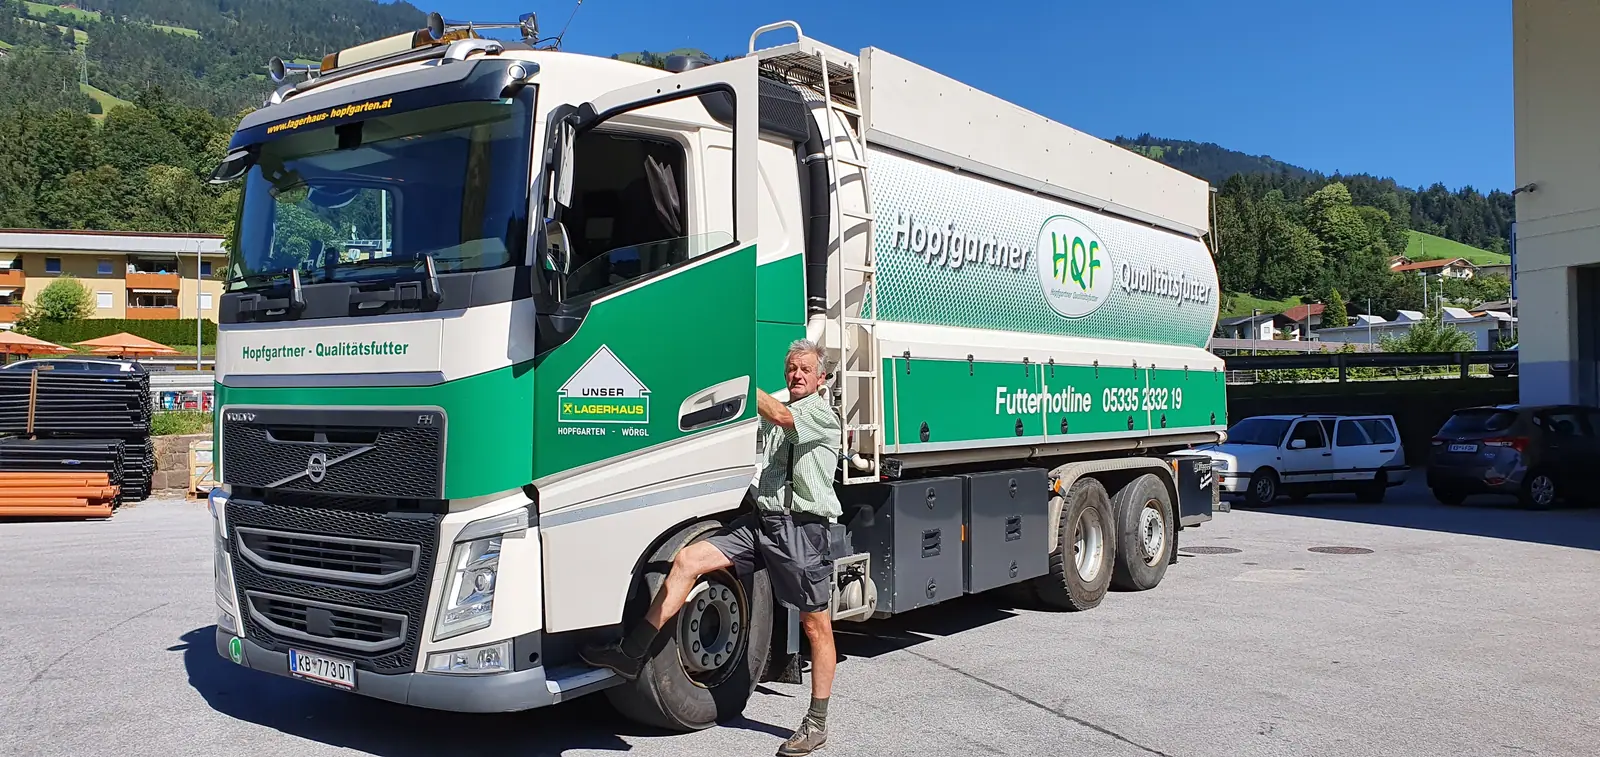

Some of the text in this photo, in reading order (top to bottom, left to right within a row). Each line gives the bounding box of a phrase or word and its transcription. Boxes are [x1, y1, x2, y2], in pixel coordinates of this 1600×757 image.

[893, 210, 1211, 304] Hopfgartner Qualitätsfutter
[1051, 231, 1101, 292] HQF
[242, 346, 306, 361] Hopfgartner
[315, 341, 409, 357] Qualitätsfutter
[582, 388, 624, 397] UNSER
[995, 385, 1182, 415] Futterhotline 05335 2332 19
[574, 405, 644, 414] LAGERHAUS
[226, 412, 257, 422] VOLVO
[417, 415, 434, 425] FH
[557, 427, 606, 436] HOPFGARTEN
[621, 426, 650, 437] WÖRGL
[298, 654, 312, 672] KB
